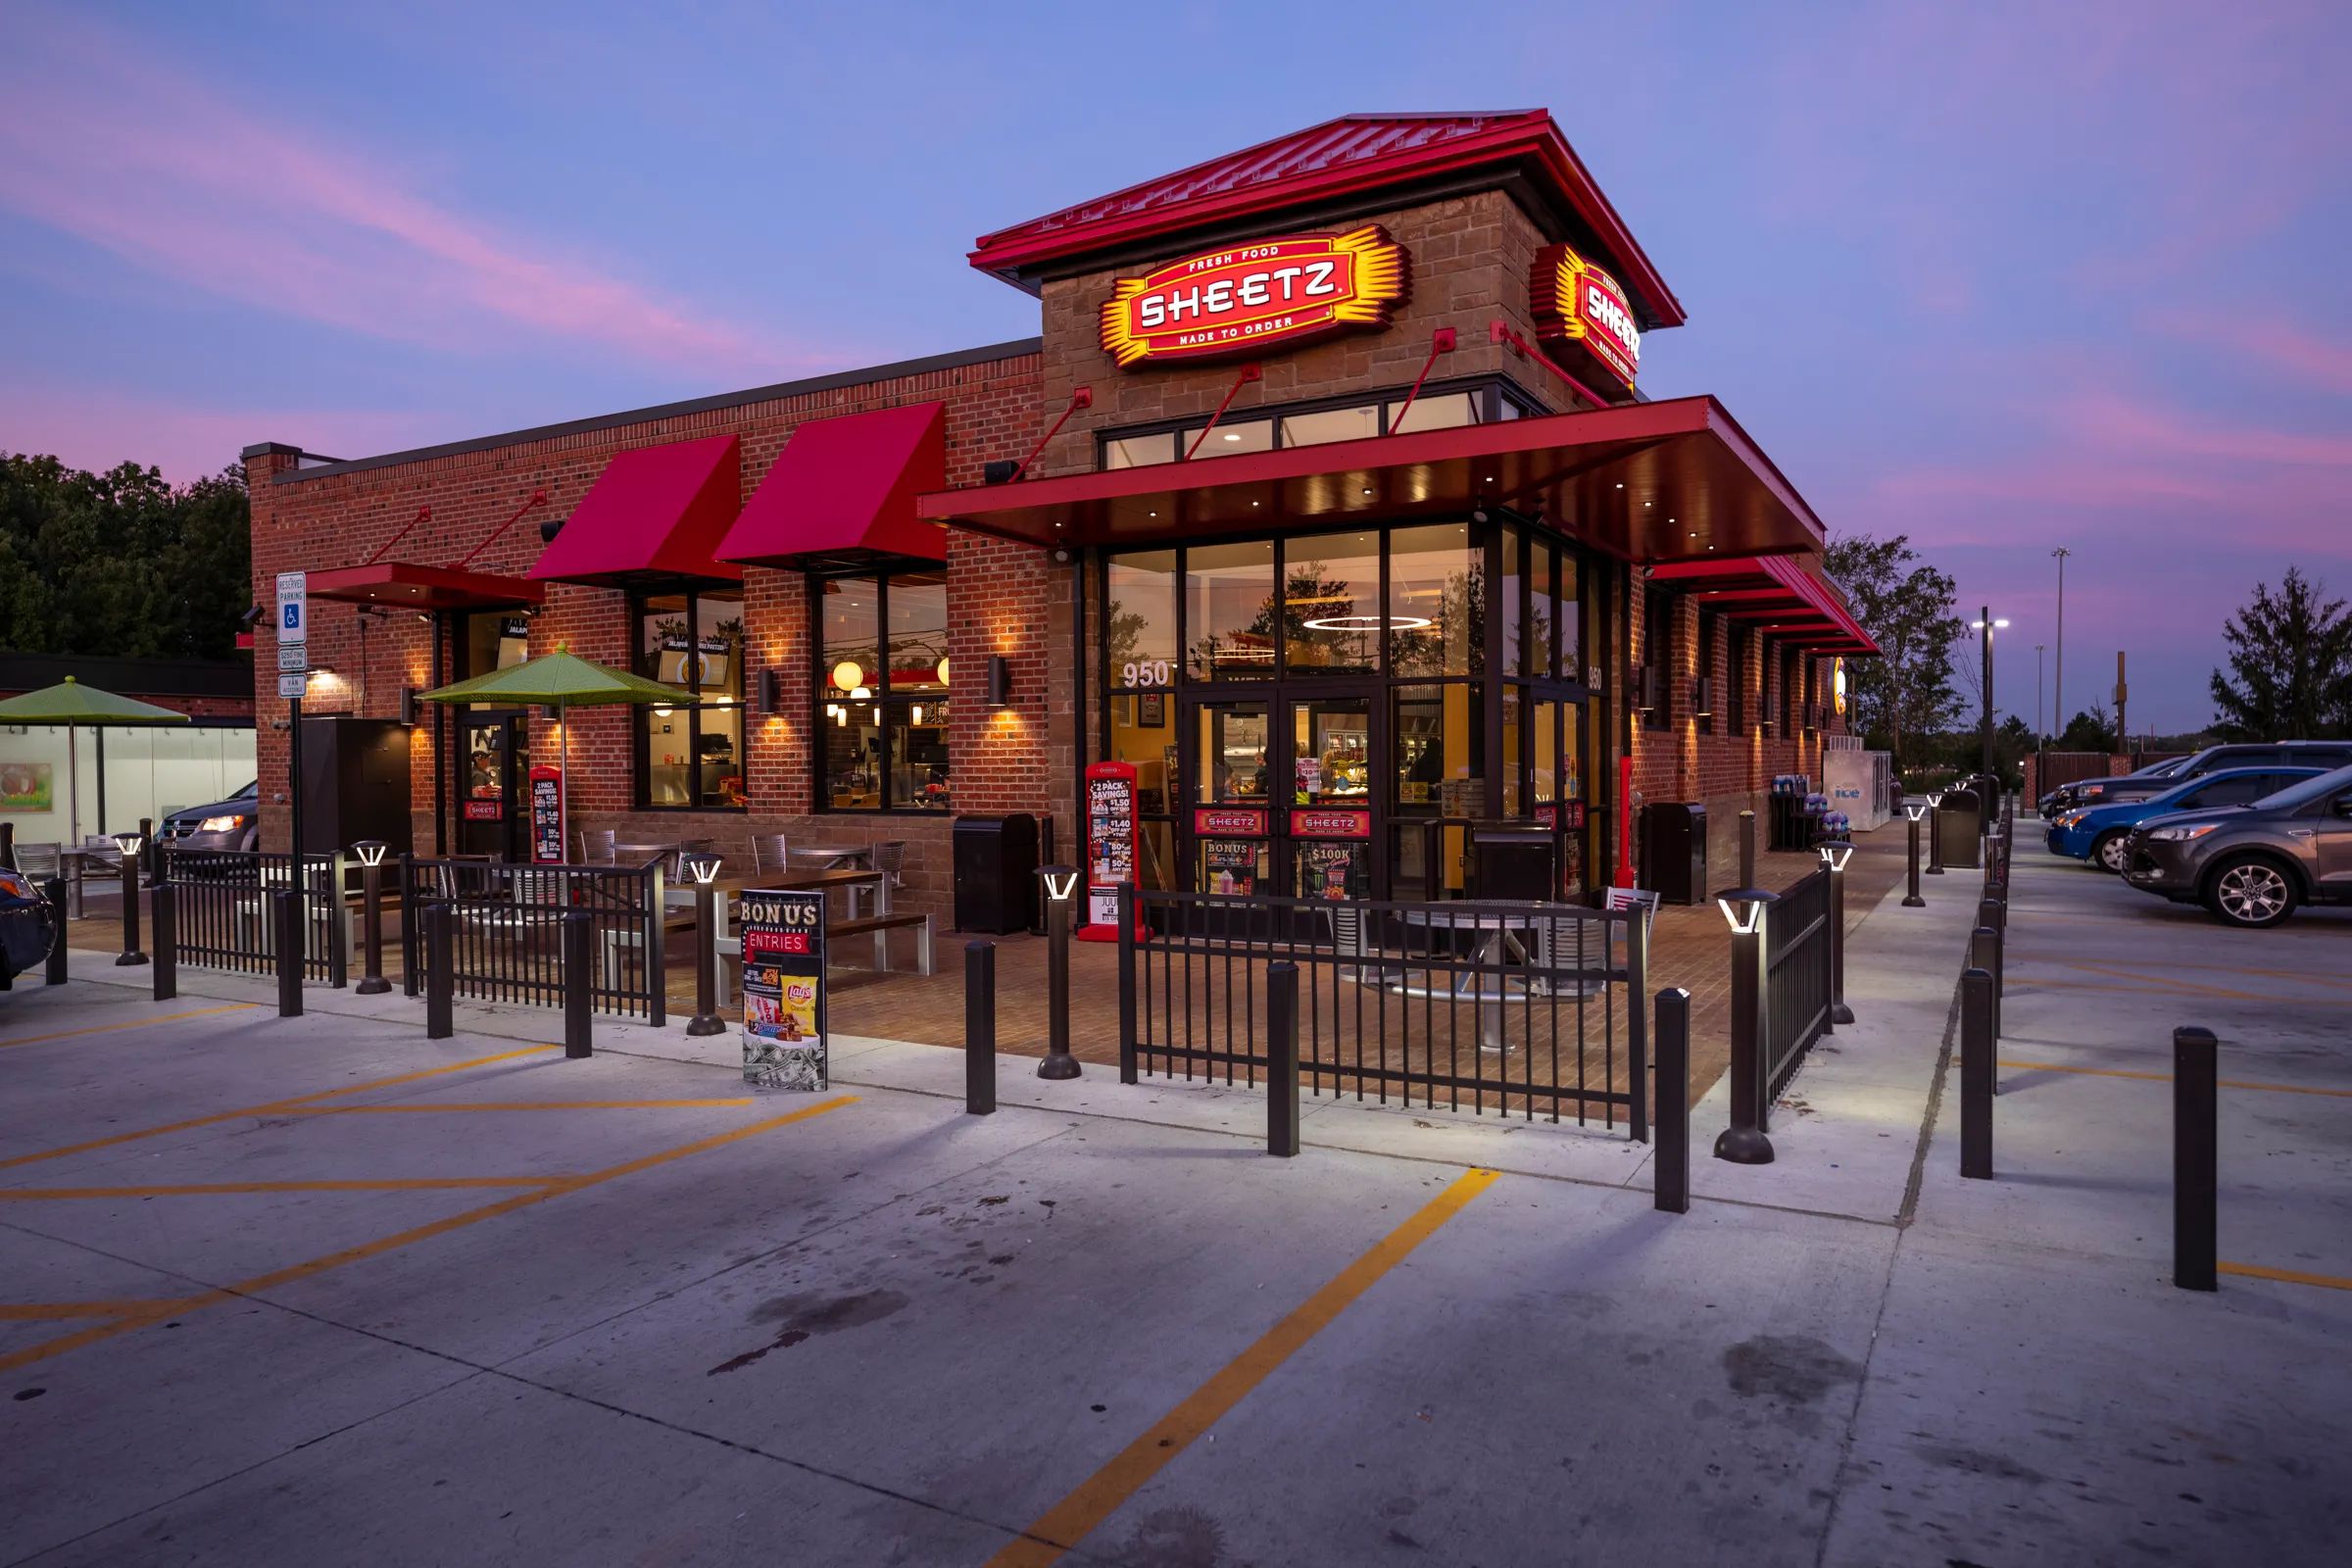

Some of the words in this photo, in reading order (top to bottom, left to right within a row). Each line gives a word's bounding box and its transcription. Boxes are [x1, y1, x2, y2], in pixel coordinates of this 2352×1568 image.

[1189, 255, 1232, 271] FRESH
[1242, 246, 1279, 260] FOOD
[1141, 262, 1334, 327] SHEETZ
[1180, 331, 1214, 345] MADE
[1221, 328, 1238, 339] TO
[1245, 317, 1293, 334] ORDER
[278, 579, 303, 590] RESERVED
[280, 592, 303, 602] PARKING
[1123, 661, 1168, 687] 950
[1589, 666, 1601, 690] 950
[1093, 790, 1129, 800] SAVINGS!
[1207, 844, 1247, 853] BONUS
[1313, 849, 1348, 860] $100K
[741, 902, 816, 925] BONUS
[750, 933, 802, 950] ENTRIES
[789, 986, 811, 998] Lay's
